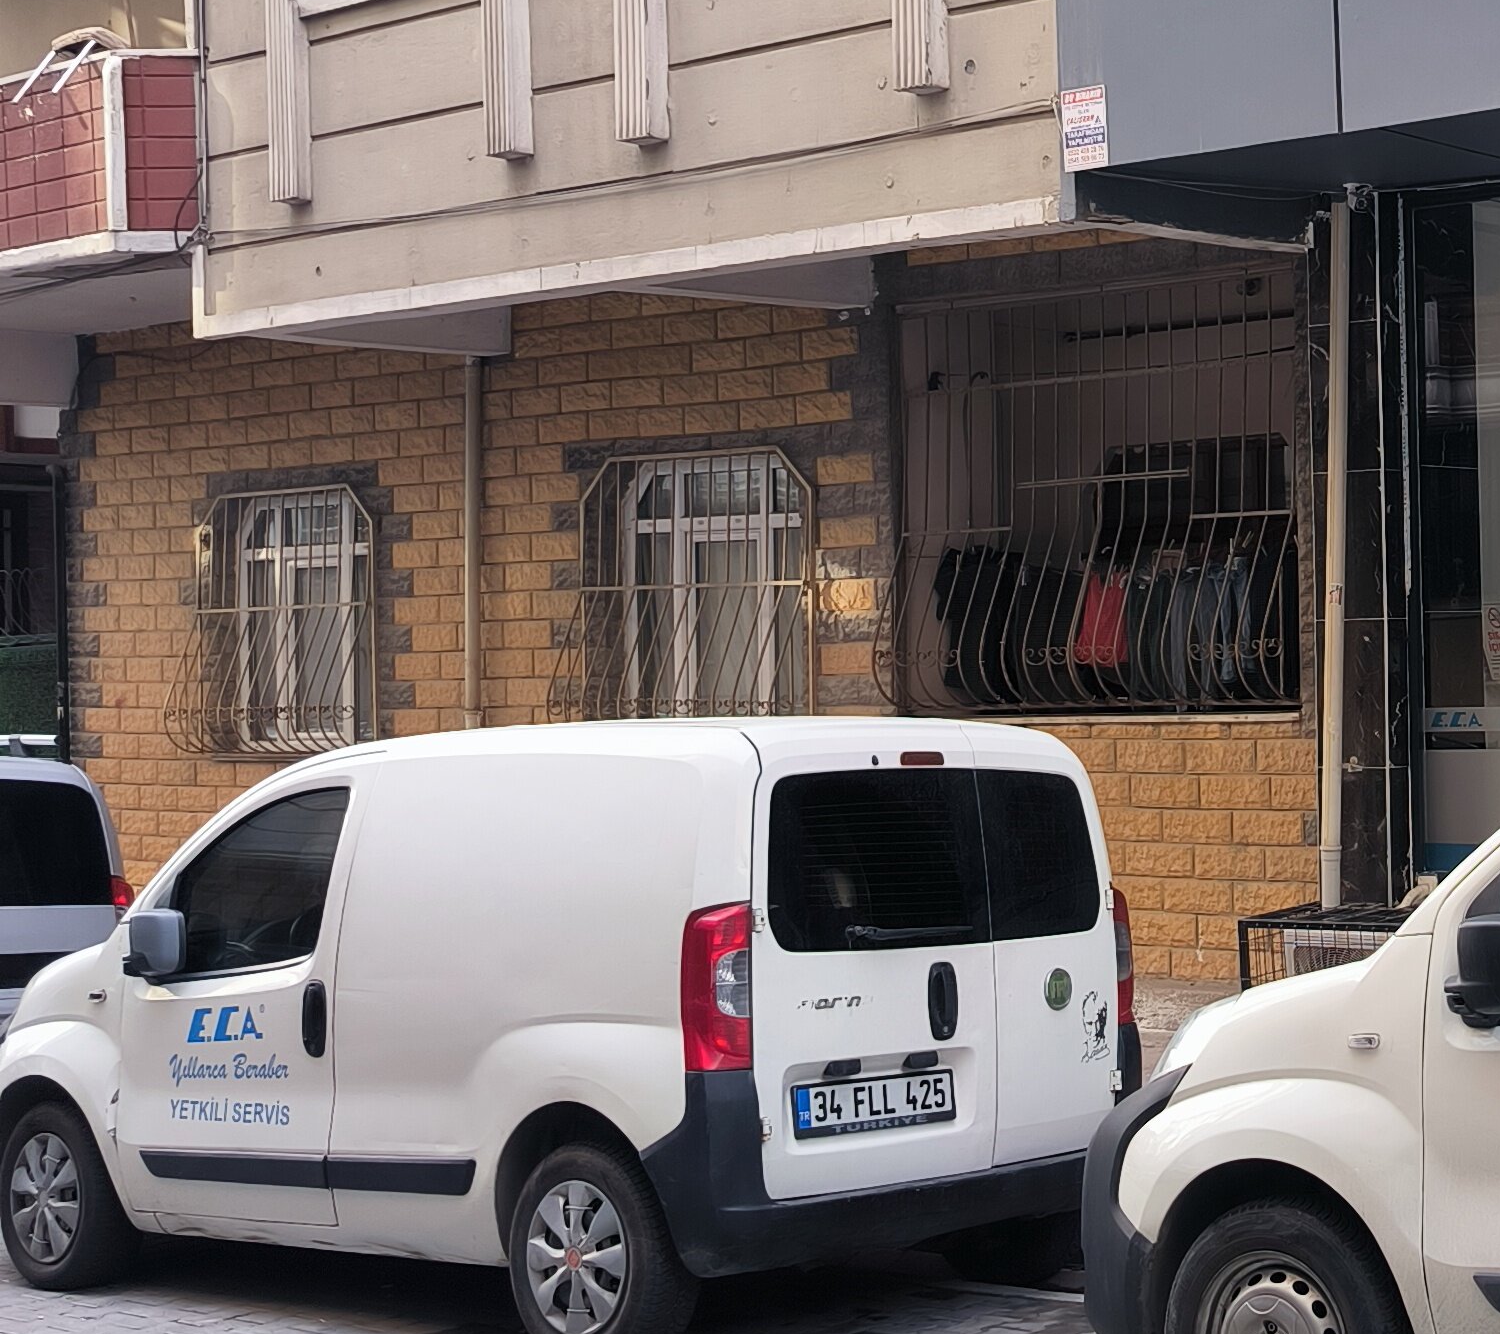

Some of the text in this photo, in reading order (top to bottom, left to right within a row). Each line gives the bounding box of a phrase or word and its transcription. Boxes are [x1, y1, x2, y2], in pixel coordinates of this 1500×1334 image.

[169, 1052, 289, 1087] Yıllarca Beraber
[170, 1096, 291, 1126] YETKİLİ SERVİS
[814, 1089, 843, 1122] 34
[853, 1084, 896, 1118] FLL
[906, 1078, 945, 1111] 425
